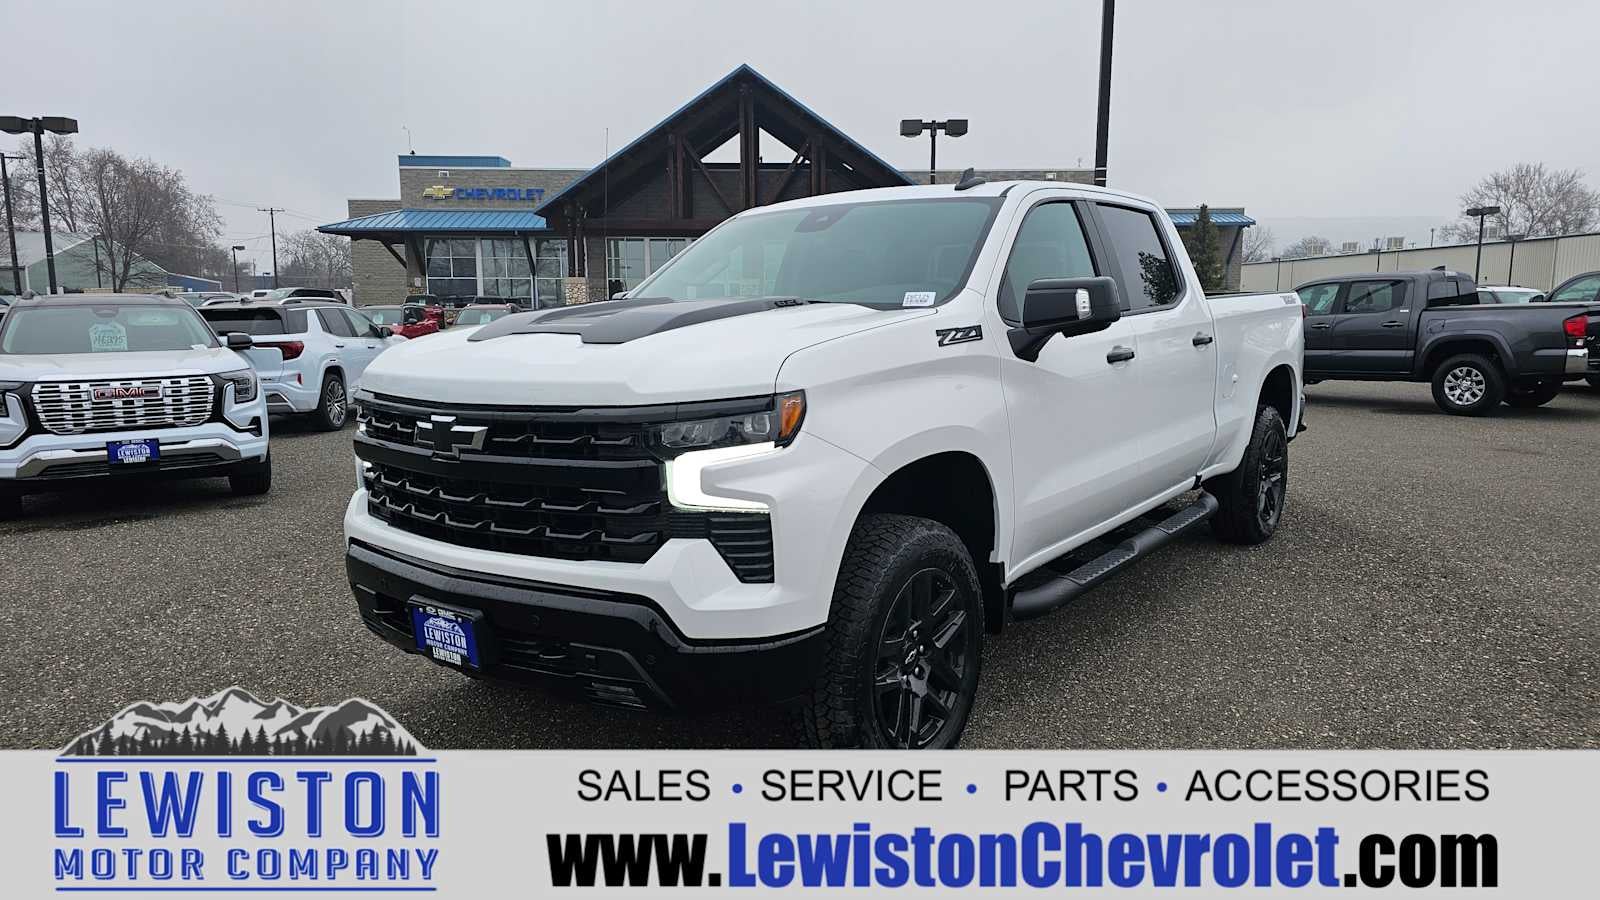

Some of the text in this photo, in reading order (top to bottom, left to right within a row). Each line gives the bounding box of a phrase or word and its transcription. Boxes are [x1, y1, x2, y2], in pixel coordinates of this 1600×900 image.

[455, 187, 545, 200] CHEVROLET
[94, 386, 160, 400] GMC
[117, 447, 150, 459] LEWISTON
[423, 626, 467, 650] LEWISTON
